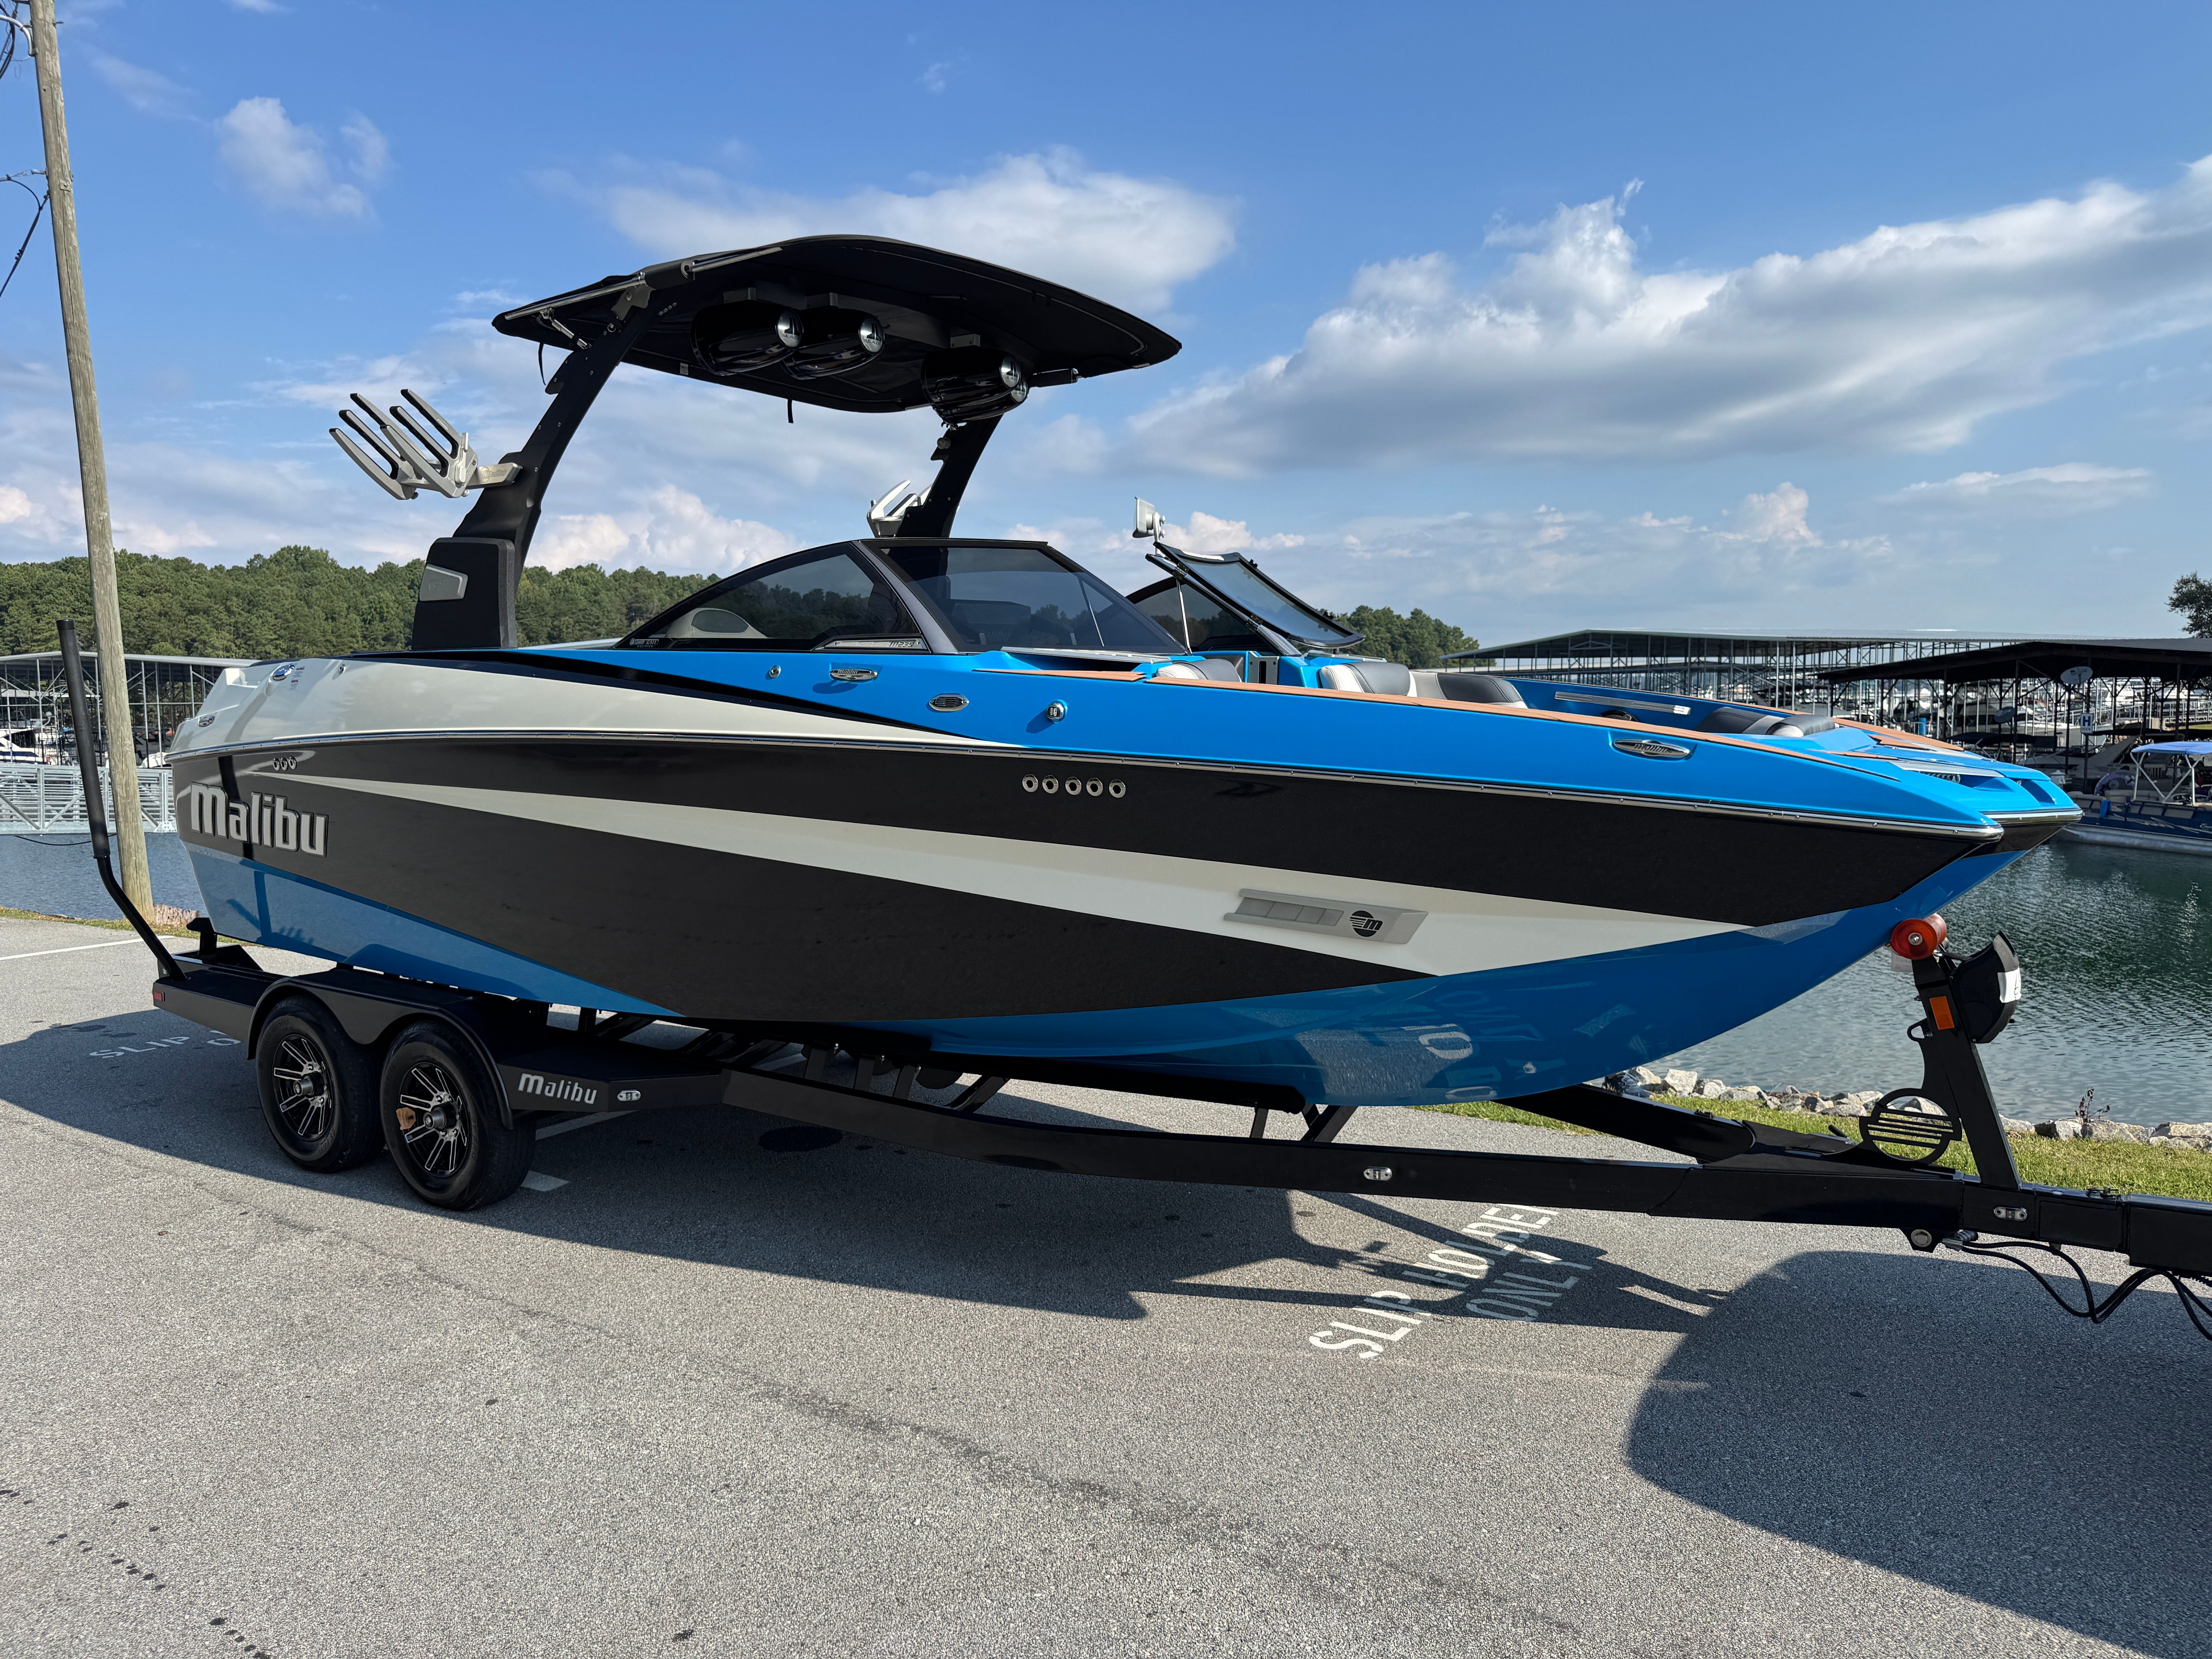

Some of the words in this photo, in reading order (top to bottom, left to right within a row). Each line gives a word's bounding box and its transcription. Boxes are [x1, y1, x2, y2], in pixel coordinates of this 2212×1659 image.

[2082, 716, 2091, 726] H
[191, 781, 329, 858] Malibu
[89, 1036, 190, 1059] SLIP
[518, 1073, 598, 1105] Malibu
[1465, 1250, 1593, 1322] ONLY
[1308, 1290, 1432, 1359] SLIP
